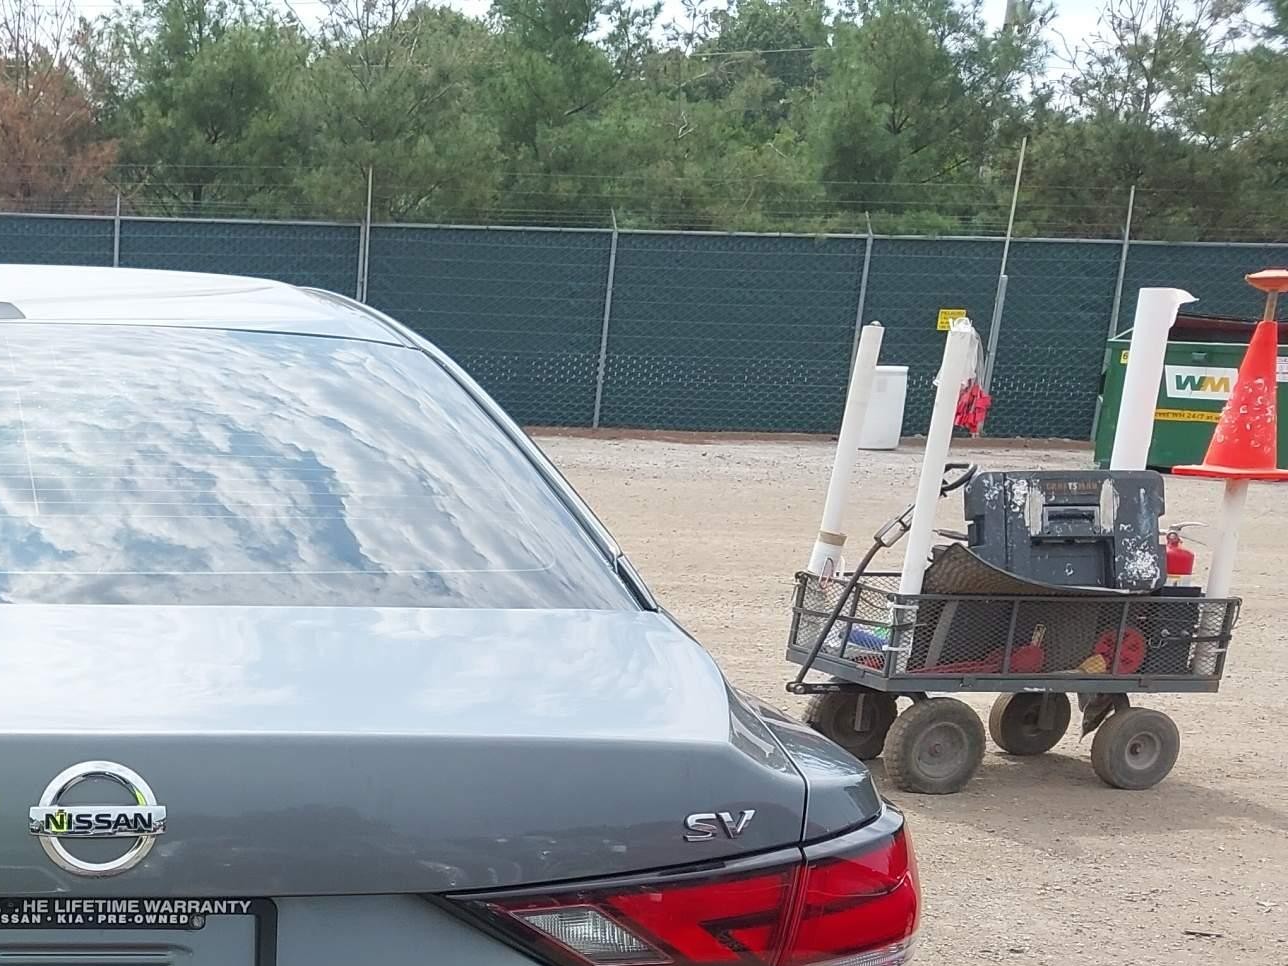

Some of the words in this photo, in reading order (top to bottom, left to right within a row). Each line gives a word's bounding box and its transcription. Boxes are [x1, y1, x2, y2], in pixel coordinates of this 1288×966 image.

[1175, 374, 1231, 393] WM
[44, 812, 153, 831] NISSAN
[683, 809, 756, 842] SV
[14, 899, 49, 914] HE
[54, 899, 140, 914] LIFETIME
[143, 899, 252, 915] WARRANTY
[57, 914, 84, 924] KIA
[97, 914, 189, 924] PRE-OWNED
